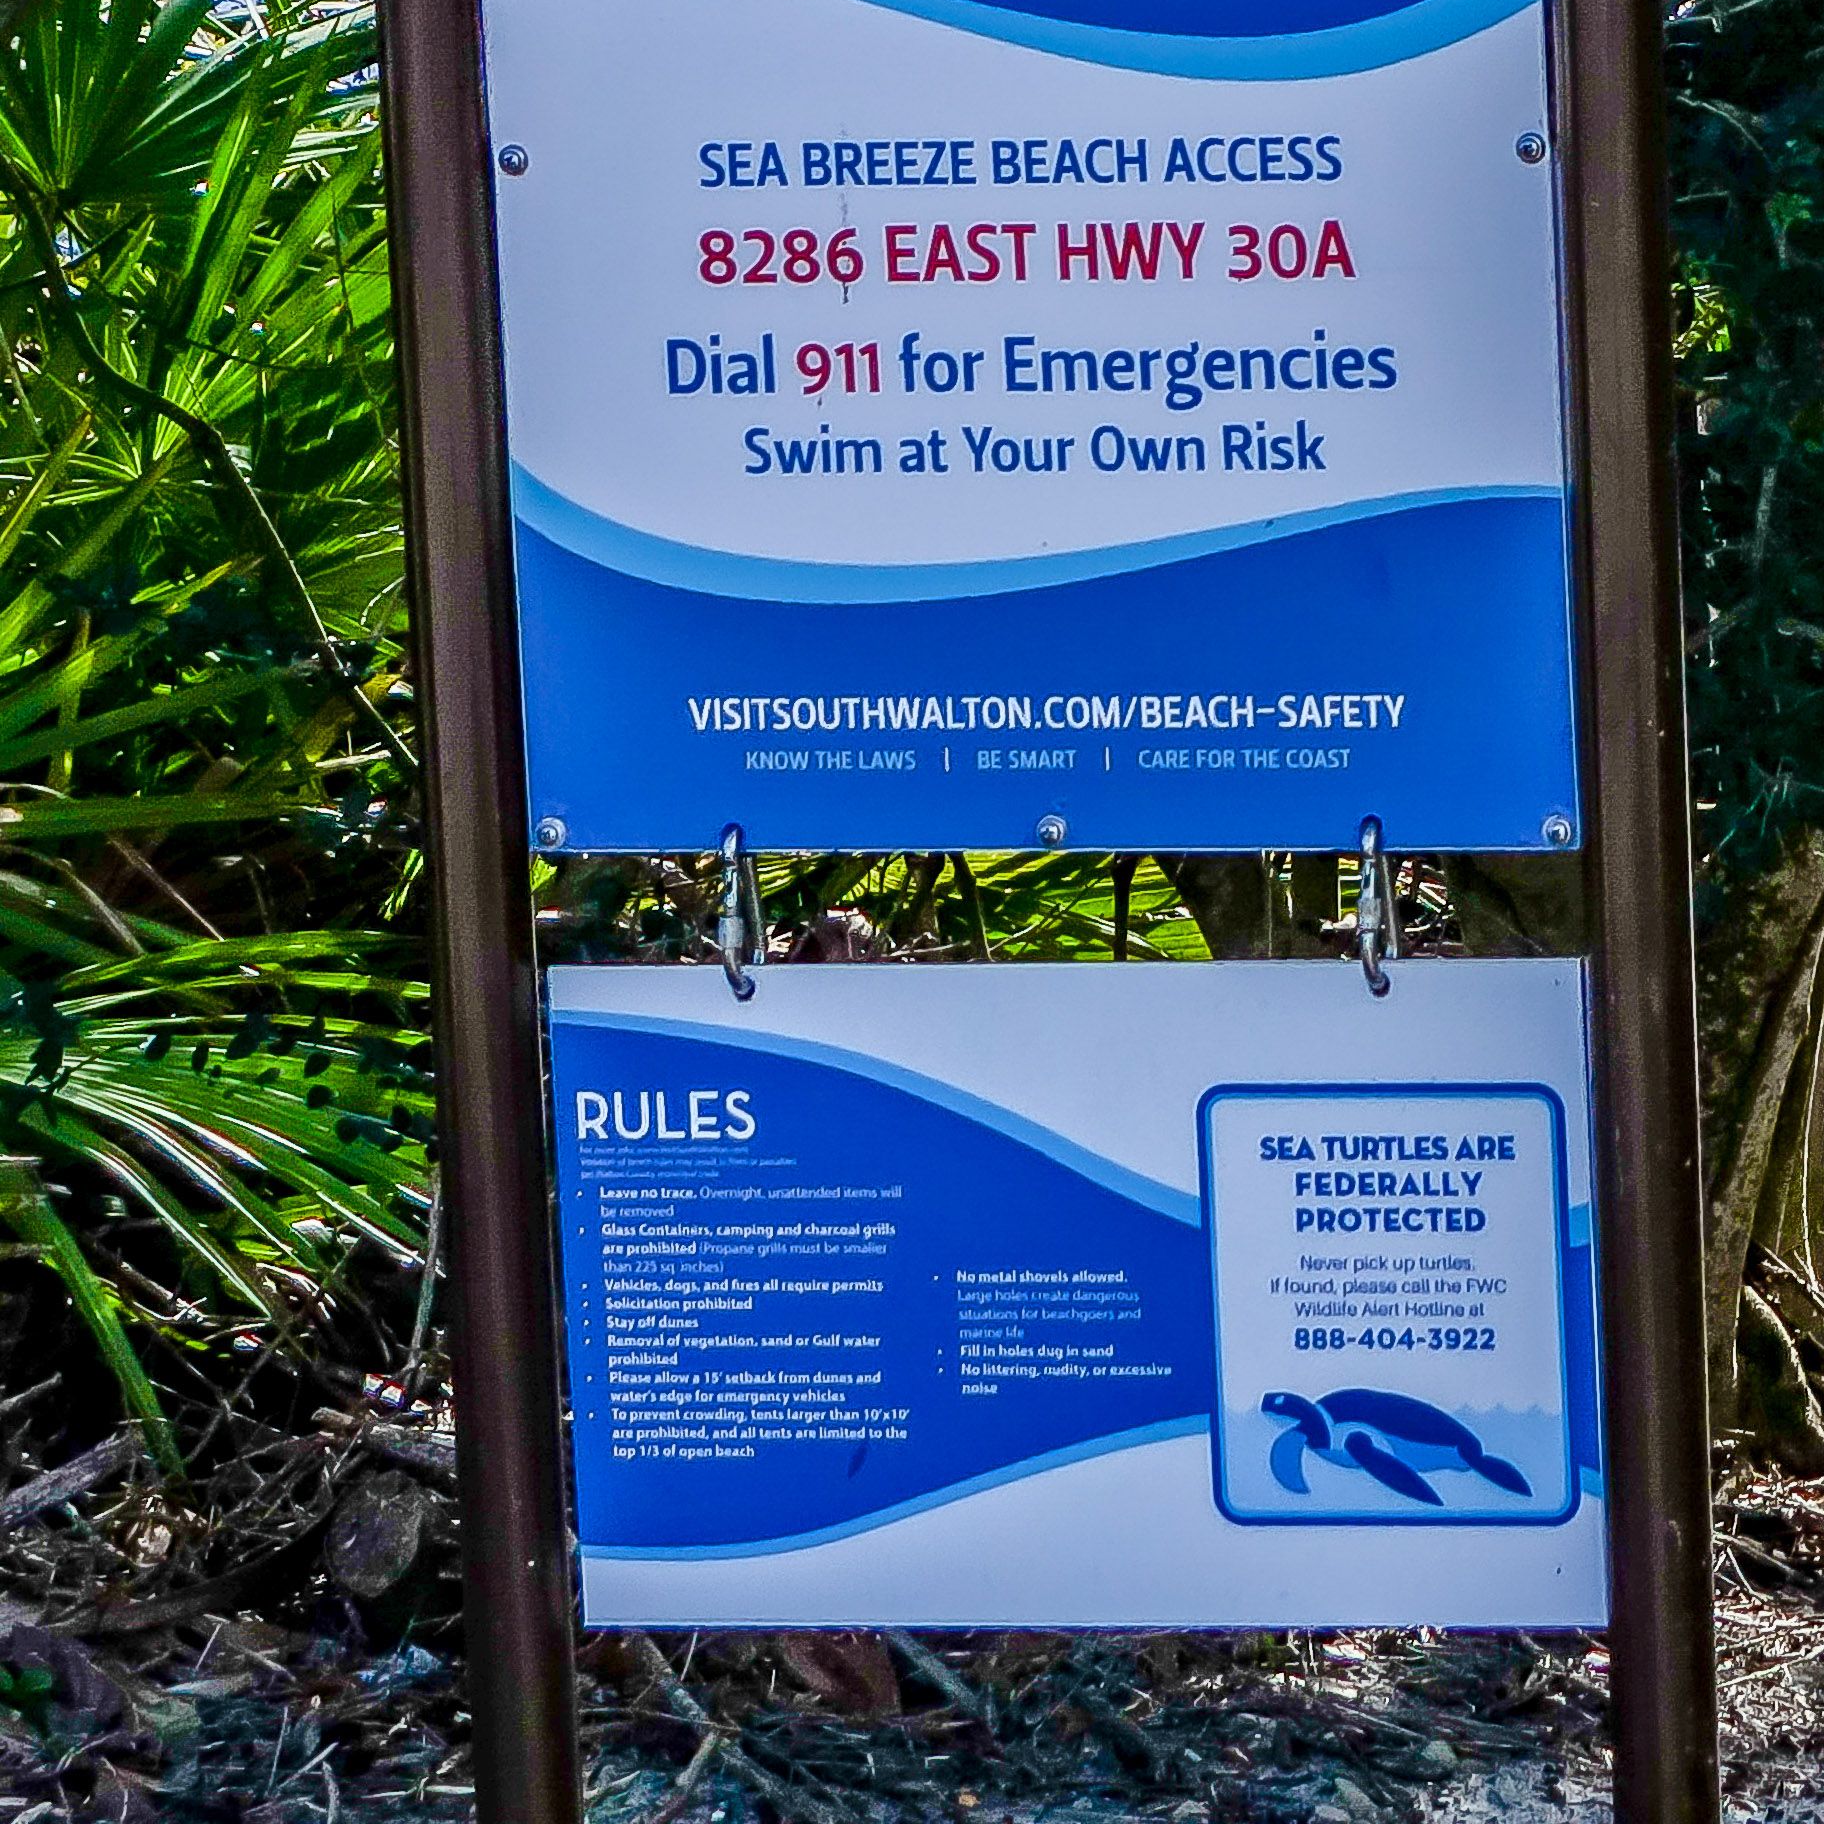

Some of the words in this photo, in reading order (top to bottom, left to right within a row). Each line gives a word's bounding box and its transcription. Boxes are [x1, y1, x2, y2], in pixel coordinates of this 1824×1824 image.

[700, 142, 788, 187] SEA
[803, 141, 976, 186] BREEZE
[992, 138, 1147, 184] BEACH
[1164, 136, 1341, 183] ACCESS
[700, 227, 863, 285] 8286
[885, 224, 1036, 282] EAST
[1058, 222, 1205, 281] HWY
[1229, 220, 1356, 281] 30A
[667, 333, 775, 395] Dial
[800, 342, 882, 396] 911
[899, 332, 984, 393] for
[1004, 329, 1396, 410] Emergencies
[745, 424, 882, 474] Swim
[900, 430, 948, 473] at
[962, 426, 1074, 473] Your
[1091, 426, 1205, 472] Own
[1223, 420, 1326, 471] Risk
[688, 695, 1404, 730] VISITSOUTHWALTON.COM/BEACH-SAFETY
[746, 751, 808, 770] KNOW
[815, 751, 852, 769] THE
[859, 751, 915, 770] LAWS
[978, 750, 1001, 769] BE
[1009, 750, 1076, 769] SMART
[1139, 749, 1189, 768] CARE
[1197, 749, 1234, 768] FOR
[1241, 749, 1279, 768] THE
[1286, 749, 1350, 769] COAST
[577, 1091, 755, 1139] RULES
[1260, 1136, 1315, 1160] SEA
[1321, 1136, 1448, 1161] TURTLES
[1455, 1135, 1515, 1161] ARE
[600, 1185, 638, 1199] Leave
[641, 1188, 658, 1198] no
[661, 1187, 697, 1199] trace.
[1296, 1171, 1482, 1196] FEDERALLY
[1296, 1207, 1485, 1232] PROTECTED
[602, 1223, 636, 1236] Glass
[639, 1224, 713, 1236] Containers,
[717, 1225, 773, 1239] camping
[777, 1223, 801, 1235] and
[805, 1223, 860, 1235] charcoal
[863, 1223, 895, 1239] grills
[603, 1244, 623, 1254] are
[626, 1240, 696, 1257] prohibited
[1301, 1255, 1347, 1271] Never
[1354, 1256, 1388, 1273] pick
[1393, 1259, 1415, 1274] up
[1420, 1255, 1475, 1271] turtles.
[957, 1269, 975, 1283] No
[979, 1269, 1016, 1283] metal
[1020, 1270, 1068, 1283] shovels
[1072, 1270, 1127, 1283] allowed.
[605, 1278, 661, 1291] Vehicles,
[664, 1278, 700, 1295] dogs,
[704, 1278, 728, 1291] and
[732, 1279, 759, 1291] fires
[763, 1279, 778, 1291] all
[782, 1280, 829, 1294] require
[832, 1280, 883, 1294] permits
[1271, 1277, 1279, 1293] If
[1285, 1276, 1337, 1295] found,
[1343, 1278, 1397, 1298] please
[1401, 1278, 1430, 1294] call
[1435, 1278, 1461, 1295] the
[1467, 1278, 1506, 1295] FWC
[606, 1296, 679, 1310] Solicitation
[683, 1296, 752, 1312] prohibited
[1295, 1300, 1357, 1317] Wildlife
[1362, 1300, 1399, 1317] Alert
[1405, 1302, 1464, 1318] Hotline
[1469, 1303, 1484, 1318] at
[607, 1315, 635, 1331] Stay
[638, 1315, 655, 1328] off
[659, 1315, 698, 1329] dunes
[608, 1333, 664, 1347] Removal
[667, 1333, 680, 1347] of
[684, 1335, 758, 1350] vegetation,
[761, 1334, 792, 1346] sand
[796, 1337, 809, 1346] or
[813, 1334, 840, 1347] Gulf
[844, 1336, 880, 1347] water
[1295, 1328, 1495, 1351] 888-404-3922
[609, 1352, 677, 1368] prohibited
[611, 1389, 656, 1403] water's
[660, 1389, 692, 1405] edge
[695, 1389, 714, 1402] for
[717, 1393, 789, 1406] emergency
[793, 1389, 845, 1402] vehicles
[612, 1408, 627, 1420] To
[630, 1409, 680, 1423] prevent
[683, 1408, 747, 1423] crowding,
[751, 1410, 784, 1420] tents
[787, 1409, 826, 1423] larger
[830, 1408, 859, 1420] than
[864, 1409, 909, 1420] 10'x10'
[612, 1429, 633, 1438] are
[636, 1425, 709, 1442] prohibited,
[713, 1426, 737, 1439] and
[740, 1426, 756, 1439] all
[759, 1428, 792, 1439] tents
[796, 1430, 816, 1439] are
[820, 1426, 865, 1439] limited
[869, 1429, 882, 1439] to
[886, 1426, 907, 1439] the
[614, 1444, 635, 1459] top
[640, 1445, 659, 1457] 1/3
[663, 1444, 676, 1457] of
[679, 1448, 712, 1460] open
[716, 1444, 754, 1457] beach
